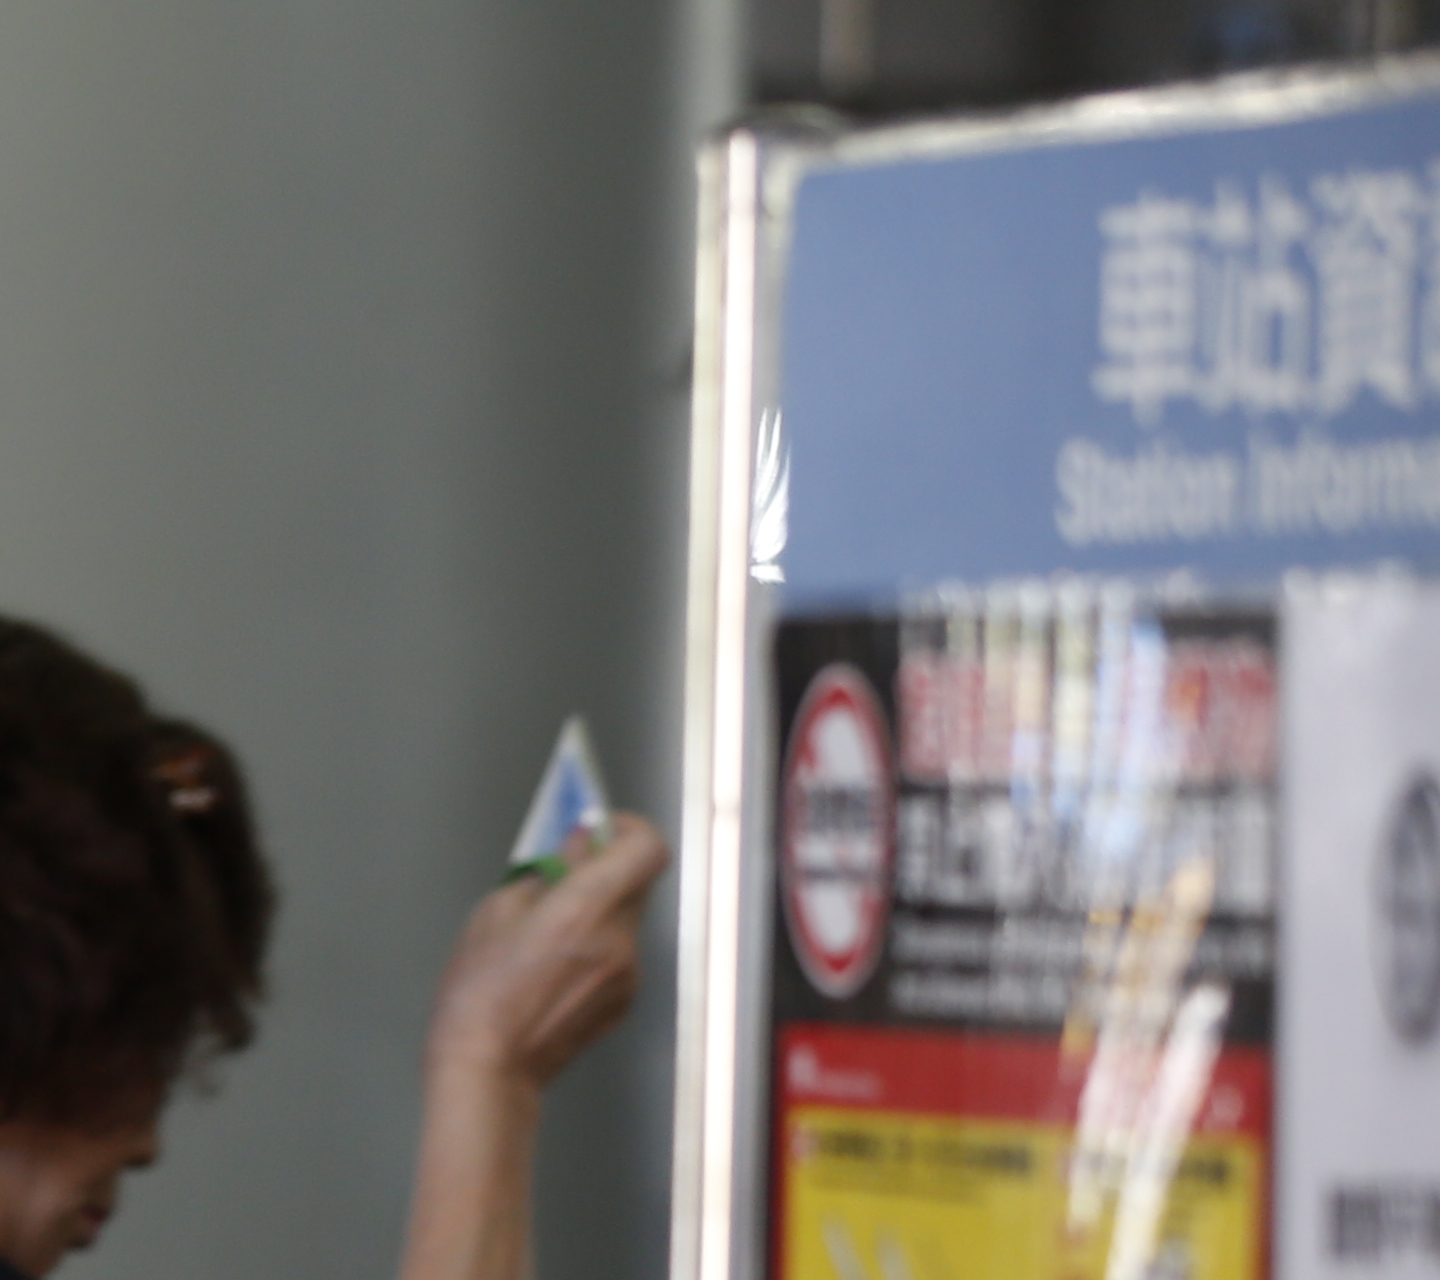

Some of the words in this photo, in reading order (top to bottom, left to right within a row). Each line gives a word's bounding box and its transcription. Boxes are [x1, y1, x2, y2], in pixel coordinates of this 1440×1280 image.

[1092, 170, 1440, 424] 車站資
[1055, 438, 1238, 546] Station
